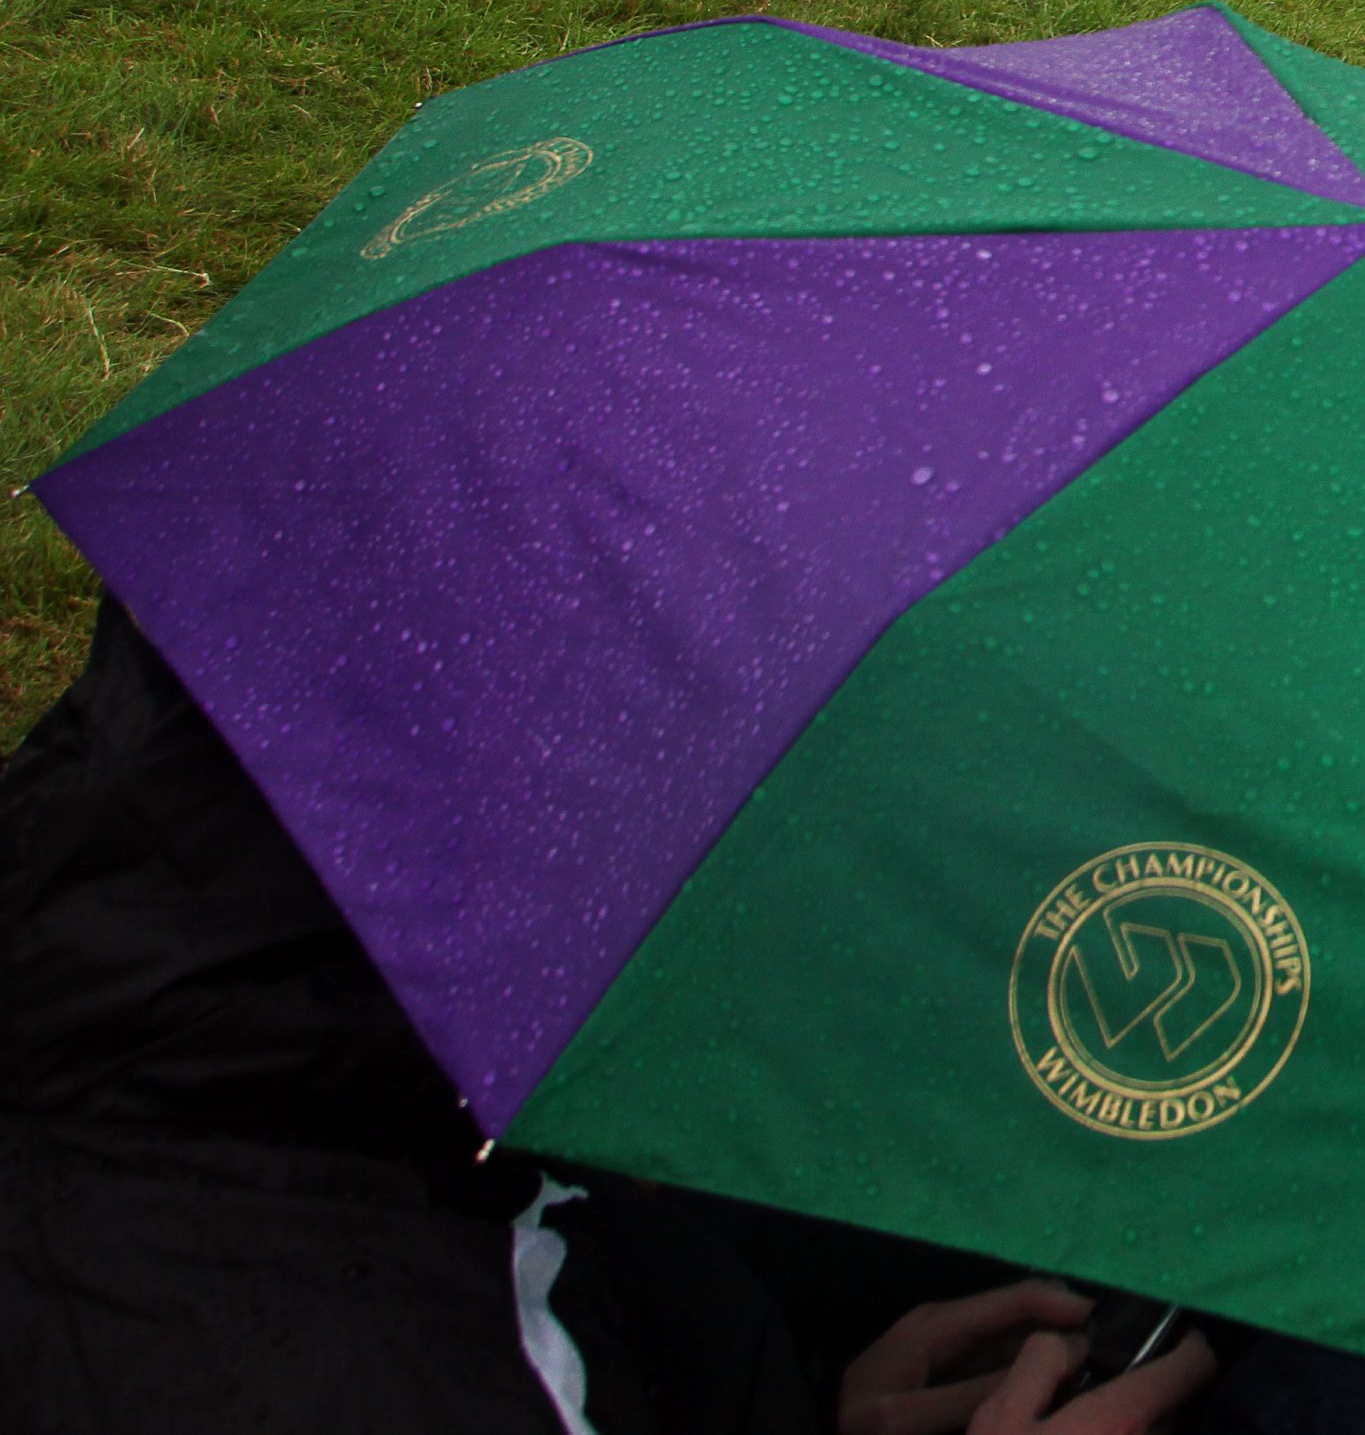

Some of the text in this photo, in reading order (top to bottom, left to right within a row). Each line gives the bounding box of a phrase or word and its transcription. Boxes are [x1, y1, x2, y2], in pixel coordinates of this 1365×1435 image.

[1033, 852, 1301, 996] THE CHAMPIONSHIPS
[1036, 1046, 1242, 1130] WIMBLEDON
